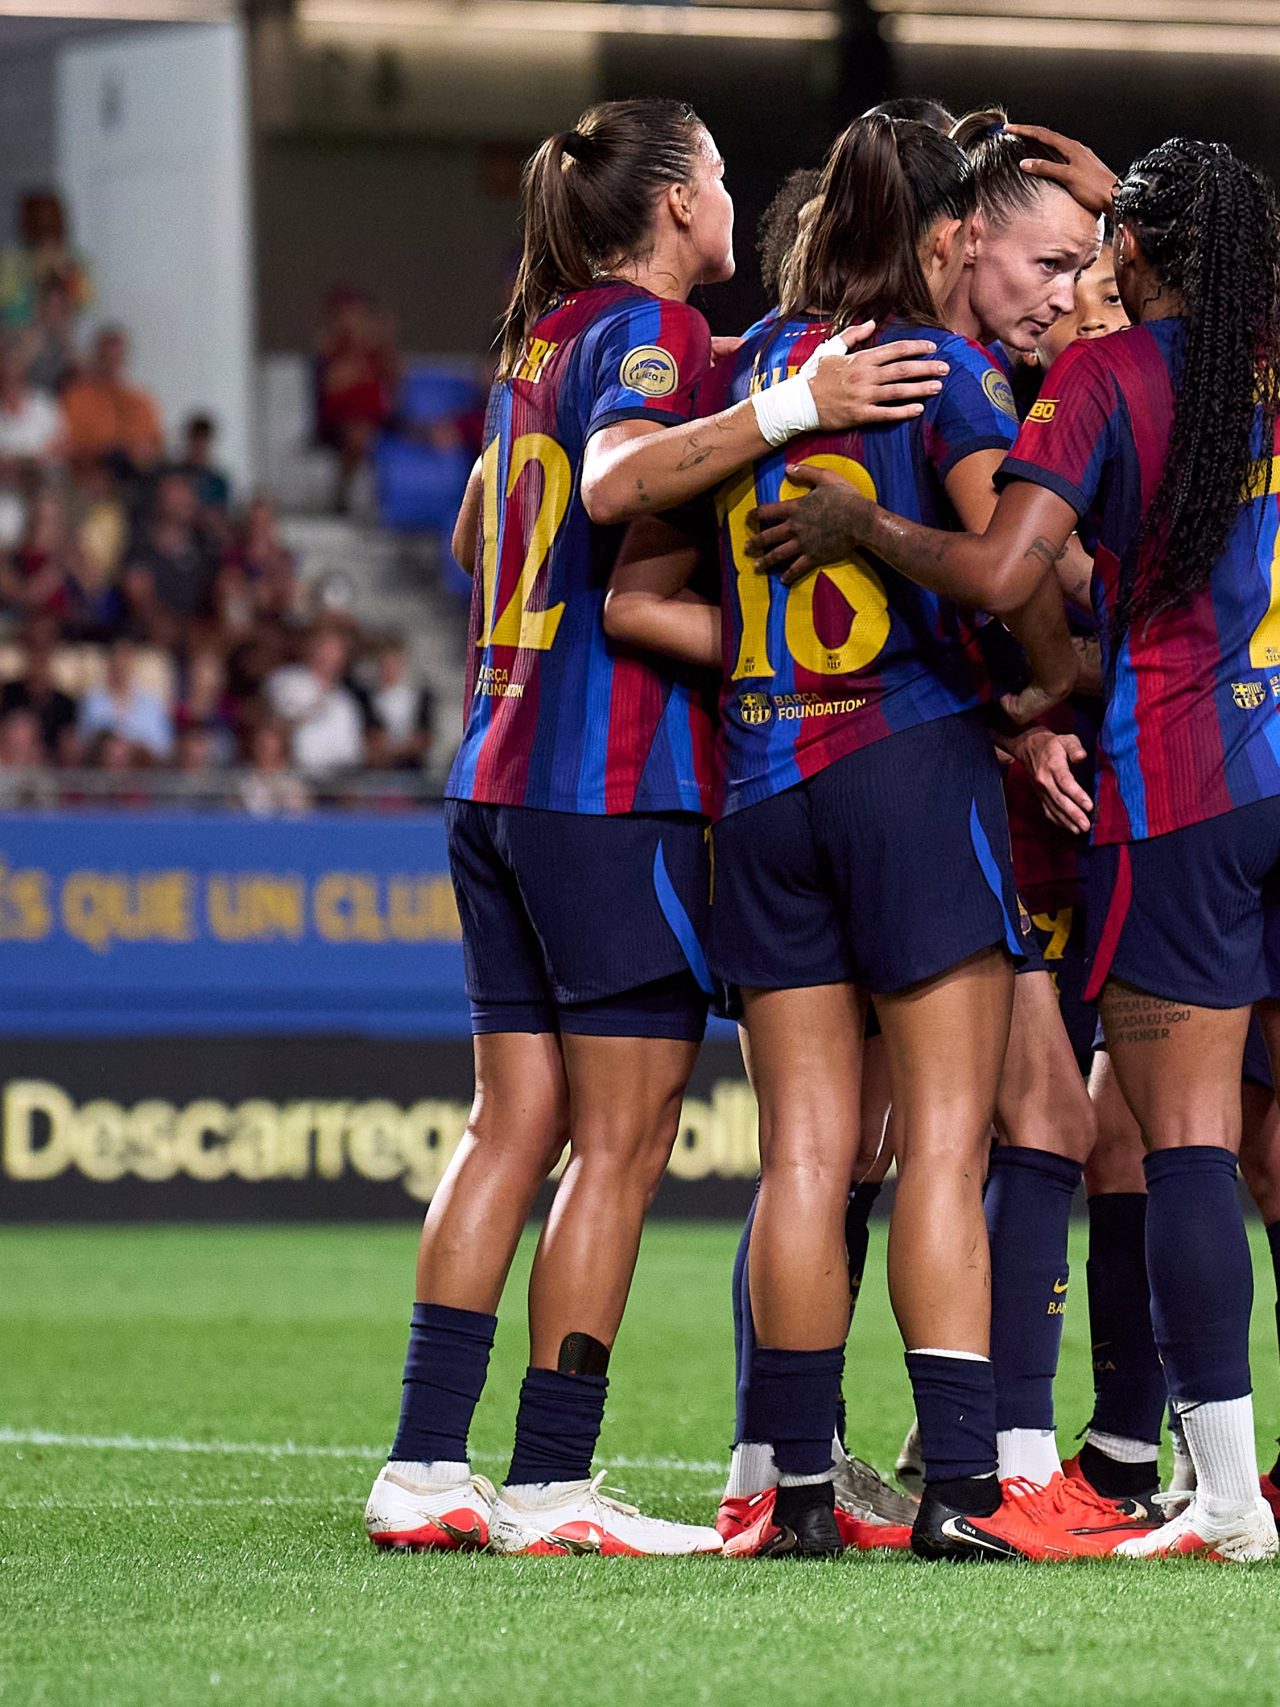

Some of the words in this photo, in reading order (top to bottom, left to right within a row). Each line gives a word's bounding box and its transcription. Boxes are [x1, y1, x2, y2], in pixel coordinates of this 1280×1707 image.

[1030, 402, 1056, 419] BO
[475, 432, 571, 651] 12
[713, 453, 891, 682] 18
[773, 692, 821, 706] BARÇA
[1165, 1009, 1191, 1024] SOU
[2, 1078, 475, 1202] Descarreg
